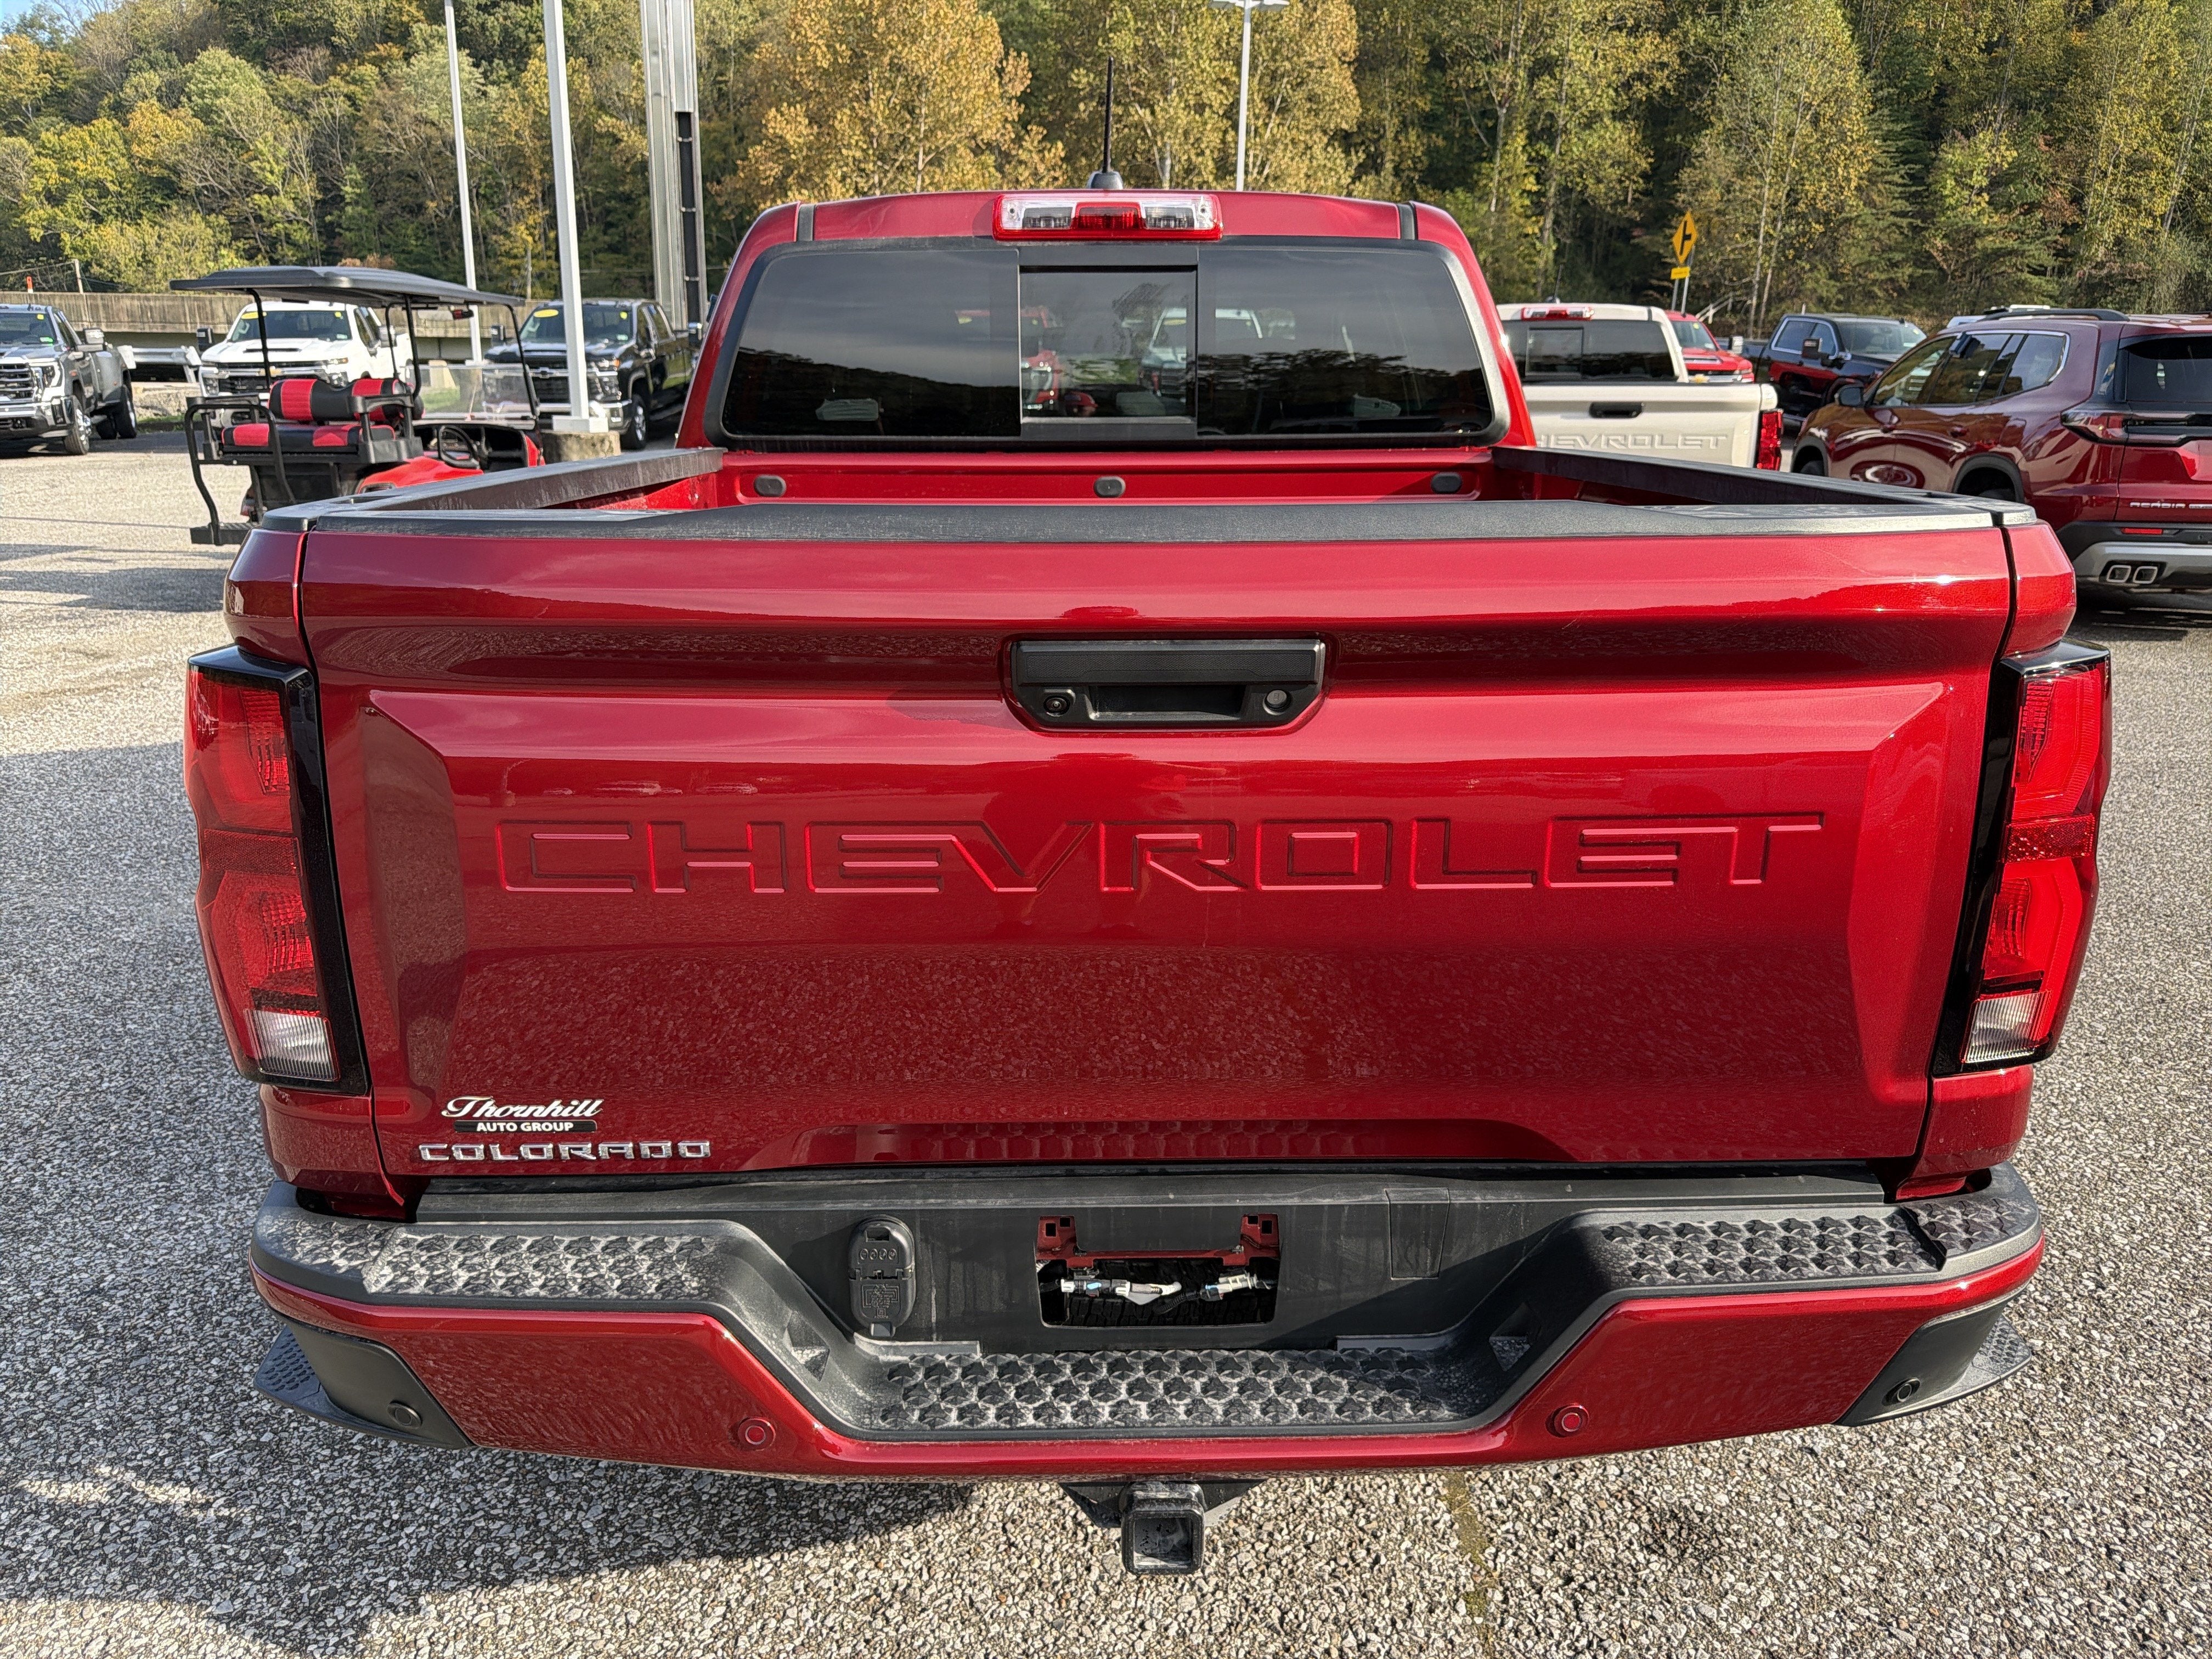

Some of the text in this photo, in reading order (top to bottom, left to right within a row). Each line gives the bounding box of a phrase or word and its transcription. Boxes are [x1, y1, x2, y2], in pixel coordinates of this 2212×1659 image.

[1536, 433, 1728, 450] EVROLET
[495, 811, 1825, 893] CHEVROLET
[441, 1095, 604, 1118] Thornhill
[476, 1121, 574, 1132] AUTO GROUP
[419, 1140, 711, 1161] COLORADO
